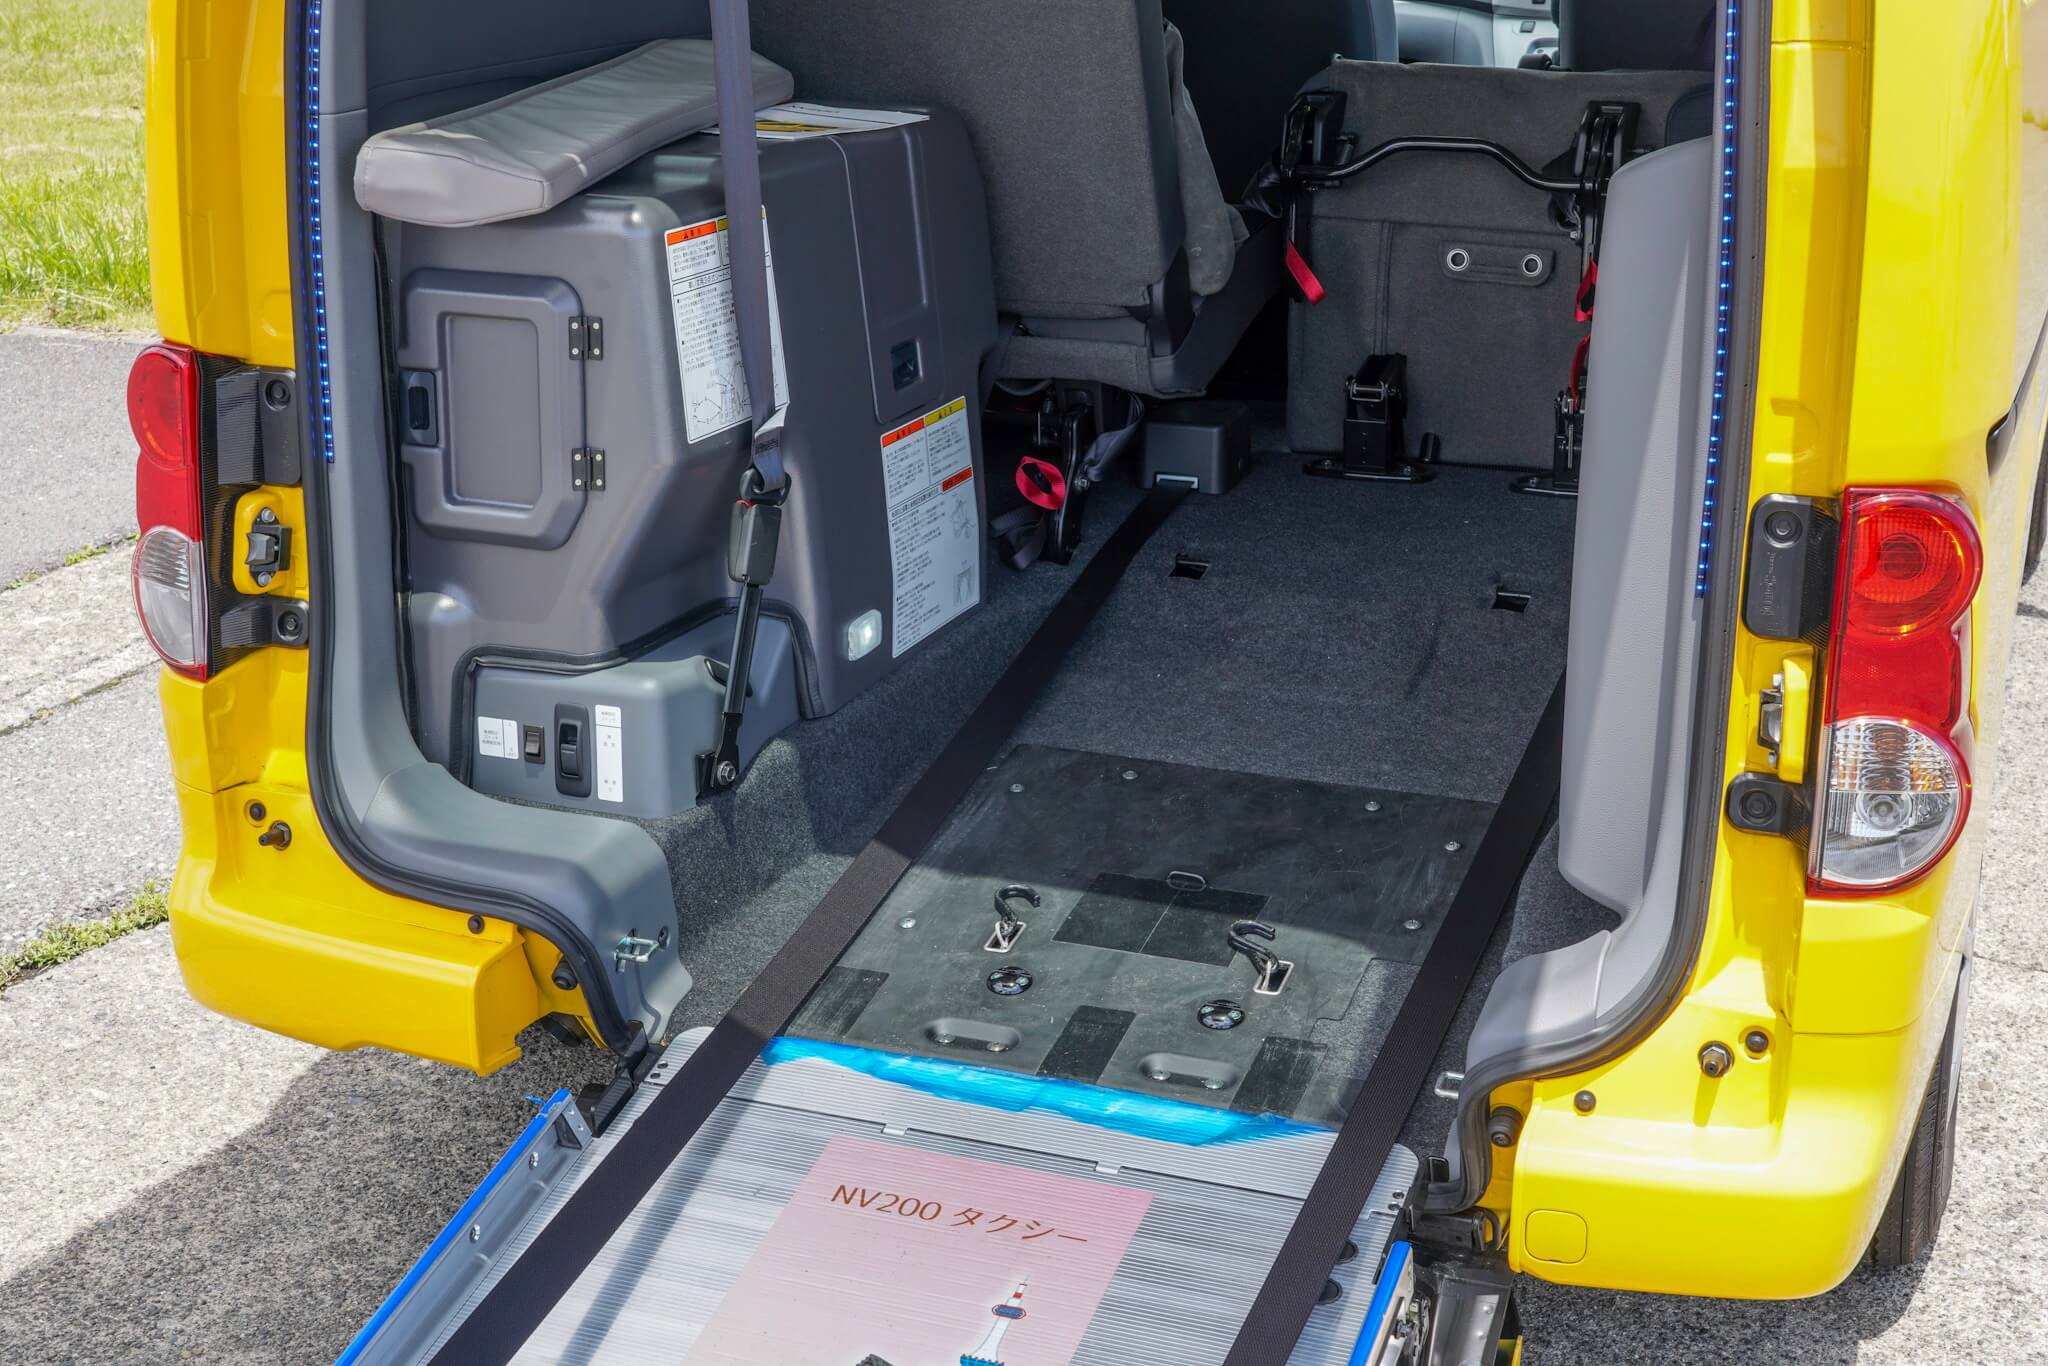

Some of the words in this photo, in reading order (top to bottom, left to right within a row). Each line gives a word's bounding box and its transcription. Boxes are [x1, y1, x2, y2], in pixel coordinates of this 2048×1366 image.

[831, 1184, 942, 1221] NV200
[950, 1207, 1088, 1242] タクシー
